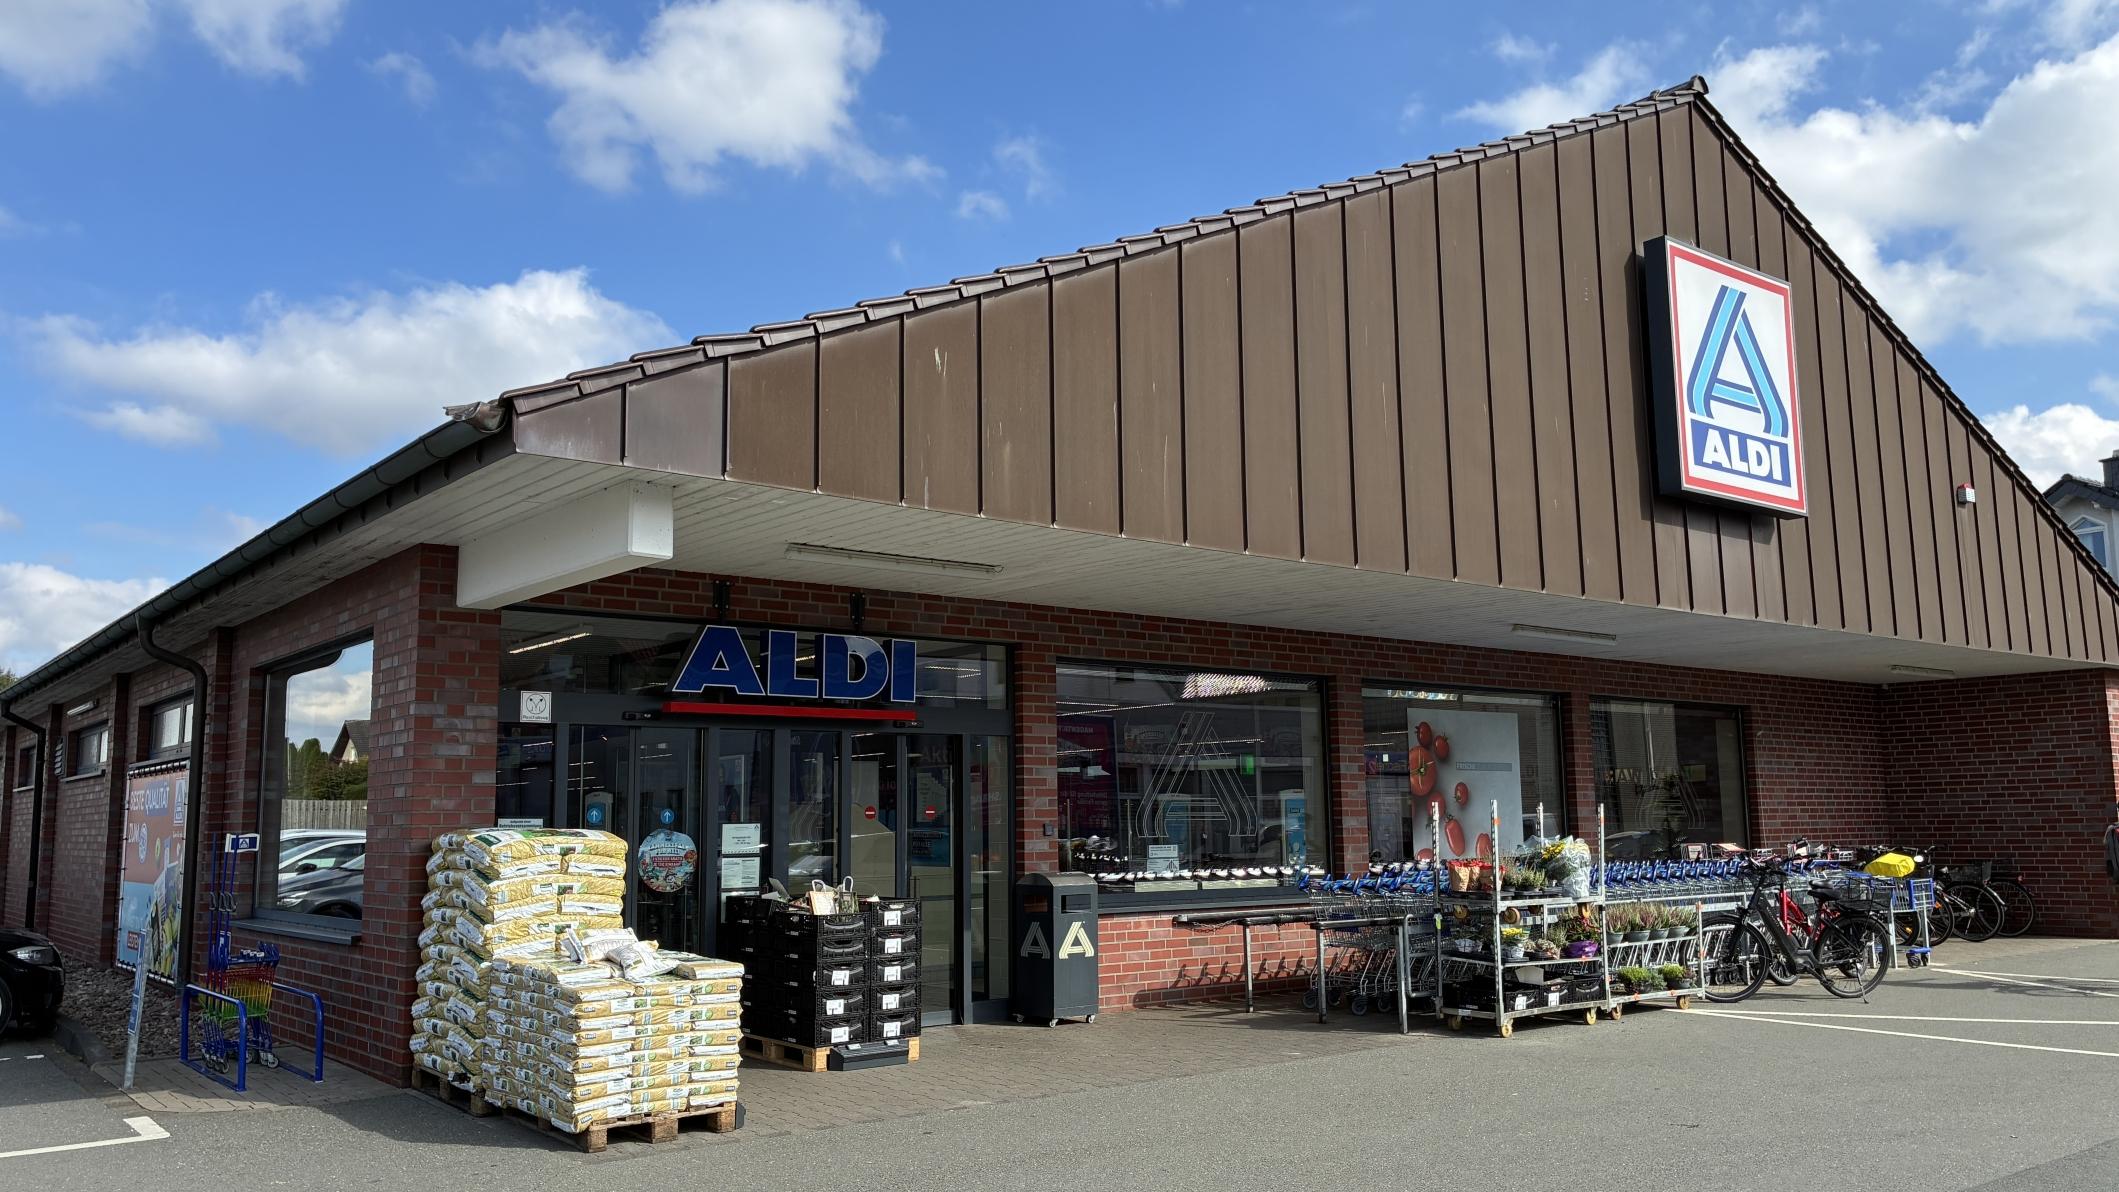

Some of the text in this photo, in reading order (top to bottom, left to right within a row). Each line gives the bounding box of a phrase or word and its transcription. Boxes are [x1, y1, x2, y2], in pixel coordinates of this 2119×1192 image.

[1703, 429, 1783, 481] ALDI
[667, 625, 916, 703] ALDI
[130, 782, 170, 815] BESTE QUALITÄT
[128, 823, 140, 843] ZUM
